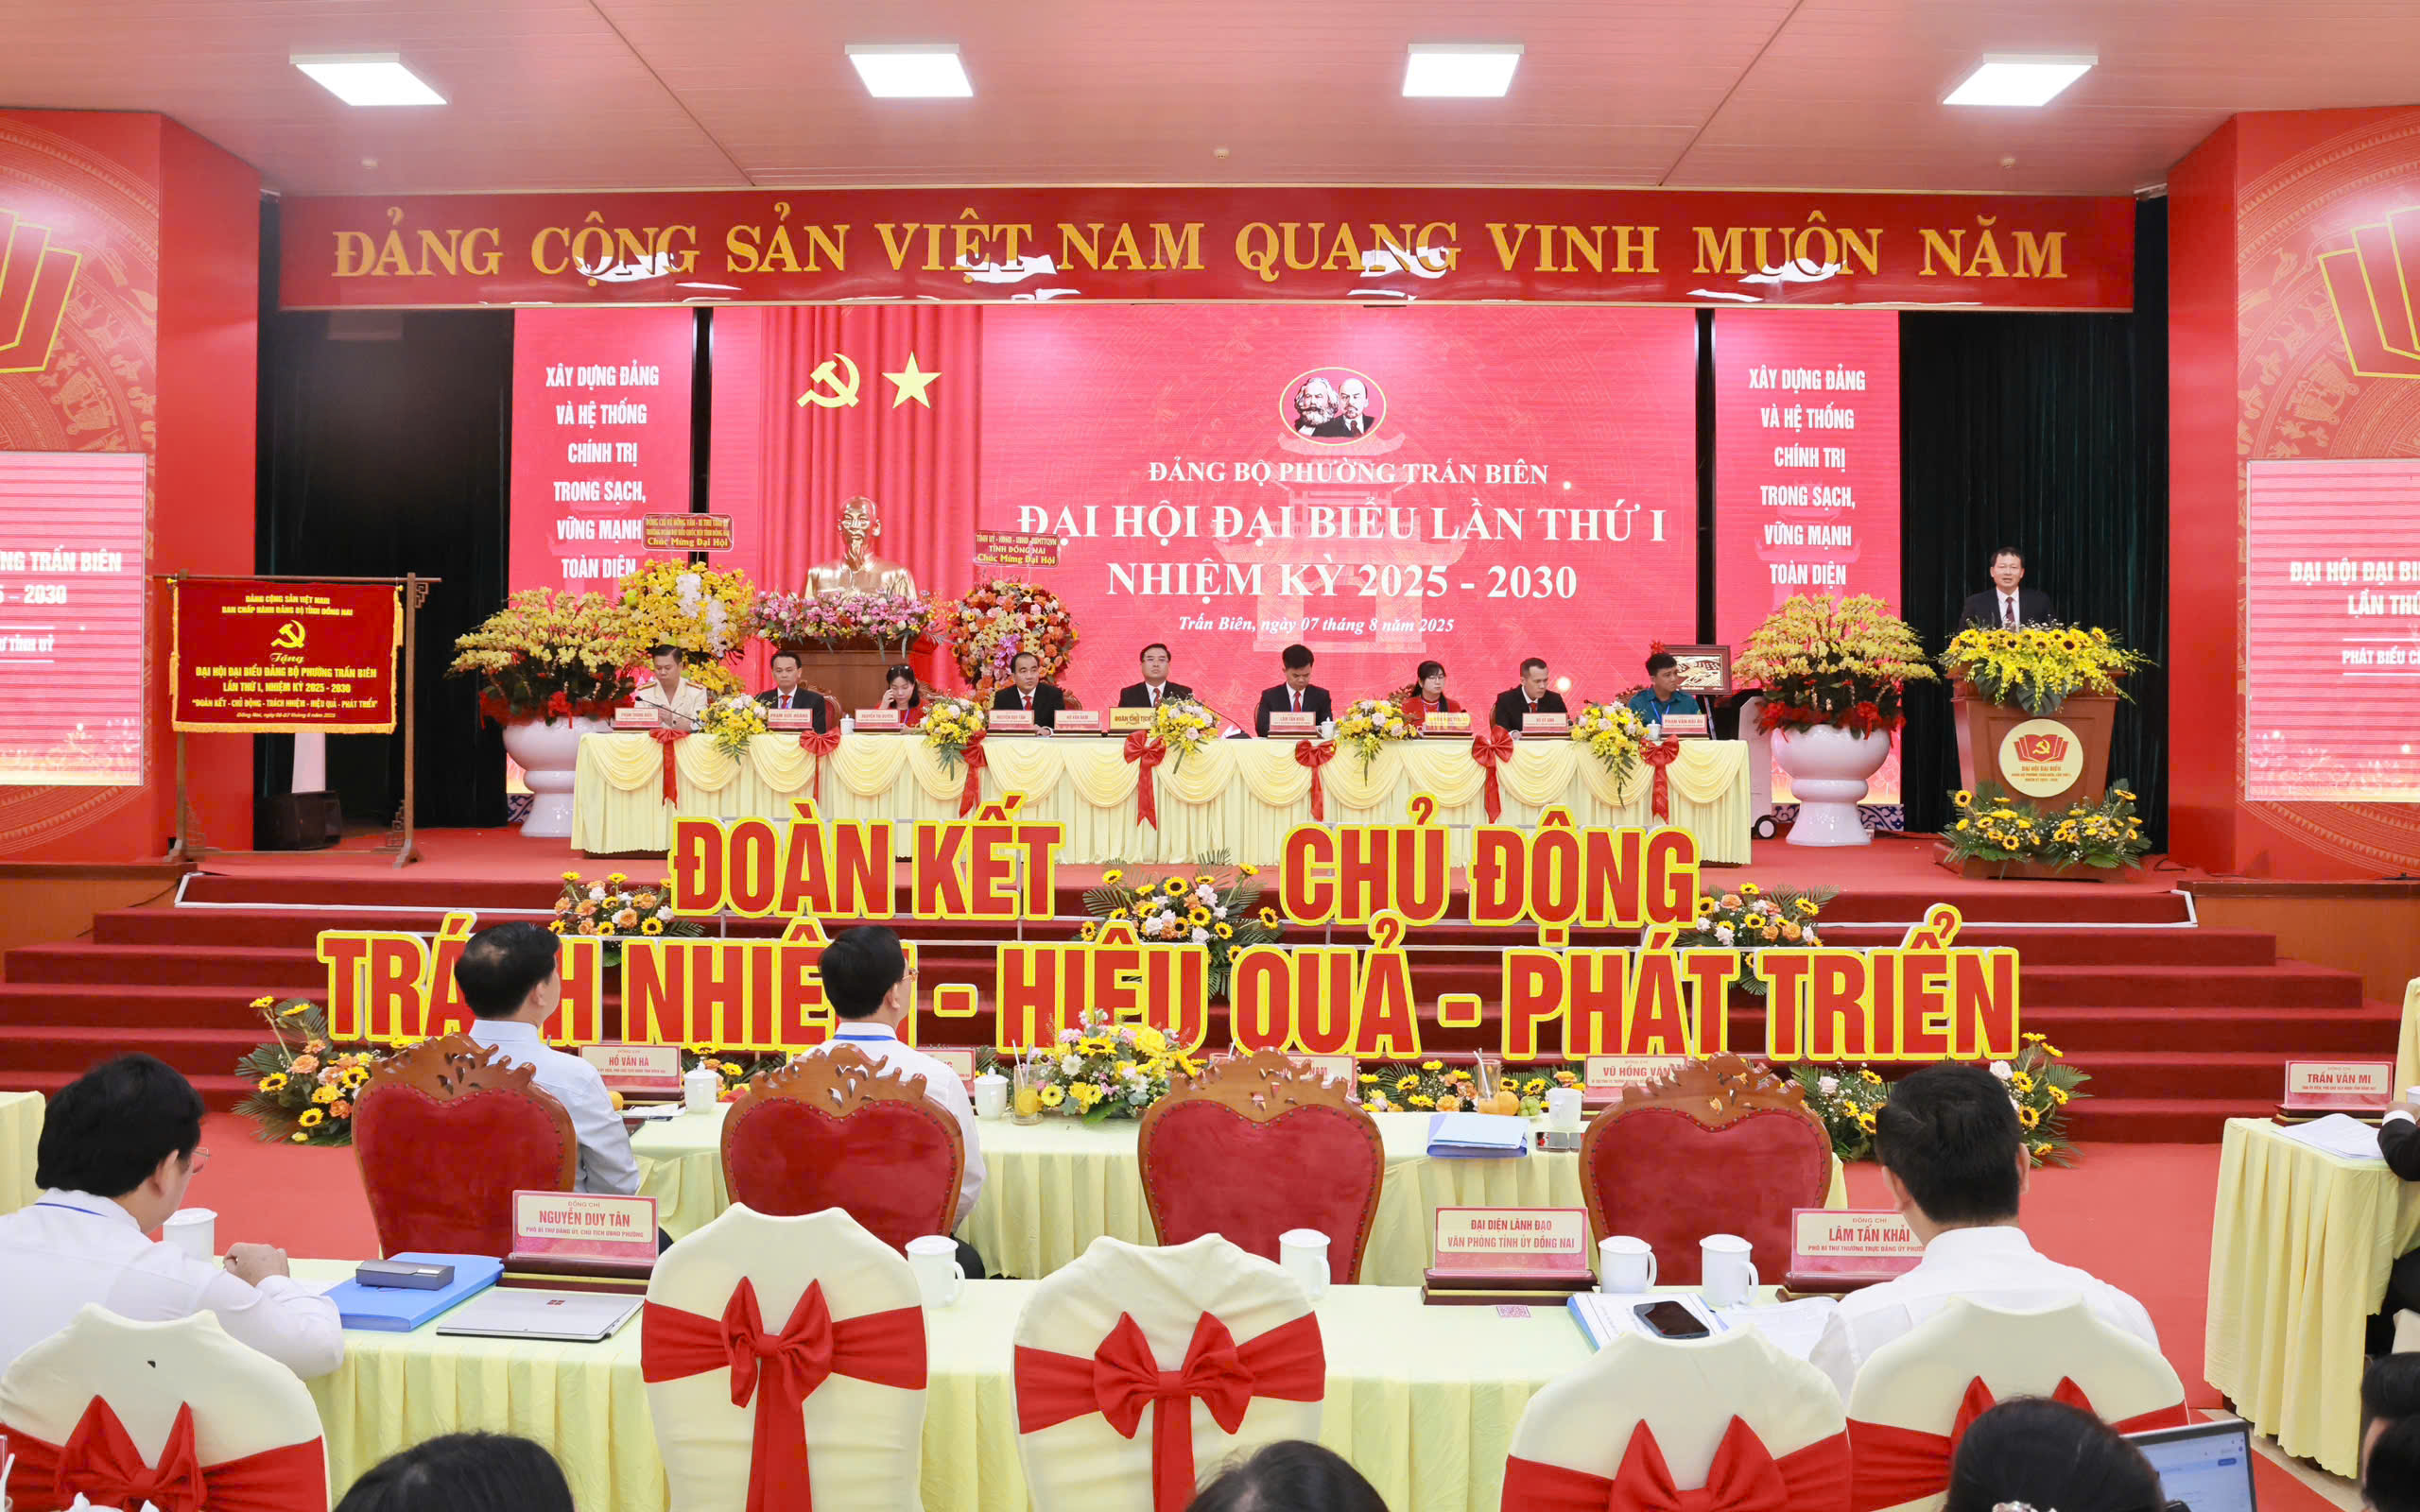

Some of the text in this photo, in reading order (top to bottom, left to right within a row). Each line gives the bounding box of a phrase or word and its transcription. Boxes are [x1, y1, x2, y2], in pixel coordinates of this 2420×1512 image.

[333, 203, 2068, 288] ĐẢNG CỘNG SẢN VIỆT NAM QUANG VINH MUÔN NĂM
[546, 360, 659, 390] XÂY DỰNG ĐẢNG
[1749, 364, 1865, 393] XÂY DỰNG ĐẢNG
[556, 397, 647, 428] VÀ HỆ THỐNG
[1761, 402, 1854, 432] VÀ HỆ THỐNG
[568, 438, 637, 467] CHÍNH TRỊ
[1774, 443, 1845, 472] CHÍNH TRỊ
[1149, 456, 1225, 481] ĐẢNG
[1234, 459, 1271, 487] BỘ
[1279, 457, 1394, 483] PHƯỜNG
[1484, 458, 1548, 485] BIÊN
[554, 481, 646, 505] TRONG SẠCH,
[1760, 486, 1856, 510] TRONG SẠCH,
[557, 516, 641, 543] VỮNG MẠNH
[1017, 496, 1667, 547] ĐẠI HỘI ĐẠI BIỂU LẦN THỨ I
[648, 537, 667, 545] Chúc
[696, 538, 711, 547] Đại
[989, 543, 1006, 553] TỈNH
[1764, 522, 1851, 550] VỮNG MẠNH
[80, 548, 121, 572] BIÊN
[562, 555, 598, 578] TOÀN
[977, 554, 997, 563] Chúc
[1025, 556, 1038, 565] Đại
[2290, 561, 2322, 585] ĐẠI
[2326, 558, 2358, 585] HỘI
[2362, 561, 2394, 585] ĐẠI
[1107, 558, 1264, 604] NHIỆM
[1278, 554, 1346, 596] KỲ
[1357, 564, 1448, 598] 2025
[1487, 565, 1577, 599] 2030
[1770, 560, 1846, 589] TOÀN DIỆN
[24, 585, 67, 604] 2030
[1218, 617, 1255, 633] Biên,
[1261, 617, 1297, 635] ngày
[1301, 617, 1320, 631] 07
[1322, 617, 1364, 635] tháng
[1369, 618, 1377, 632] 8
[1382, 619, 1415, 632] năm
[1418, 618, 1455, 632] 2025
[2342, 647, 2375, 664] PHÁT
[305, 682, 325, 693] 2025
[668, 790, 1701, 947] ĐOÀN KẾT CHỦ ĐỘNG
[318, 911, 603, 1046] TRÁH
[1231, 908, 1422, 1060] QUẢ
[1501, 925, 1740, 1060] PHÁT
[1754, 902, 2019, 1060] TRIỂN
[621, 1056, 637, 1066] VĂN
[1603, 1065, 1616, 1076] VŨ
[2336, 1072, 2356, 1084] VĂN
[2359, 1074, 2371, 1084] MI
[539, 1208, 631, 1228] NGUYỄN DUY TÂN
[1471, 1217, 1552, 1232] ĐẠI DIỆN LÃNH ĐẠO
[1447, 1235, 1465, 1247] VĂN
[1467, 1234, 1496, 1247] PHÒNG
[1499, 1234, 1518, 1248] TỈNH
[1533, 1235, 1557, 1248] ĐỒNG
[1560, 1238, 1575, 1248] NAI
[1829, 1224, 1910, 1243] LÂM TẤN KHẢI
